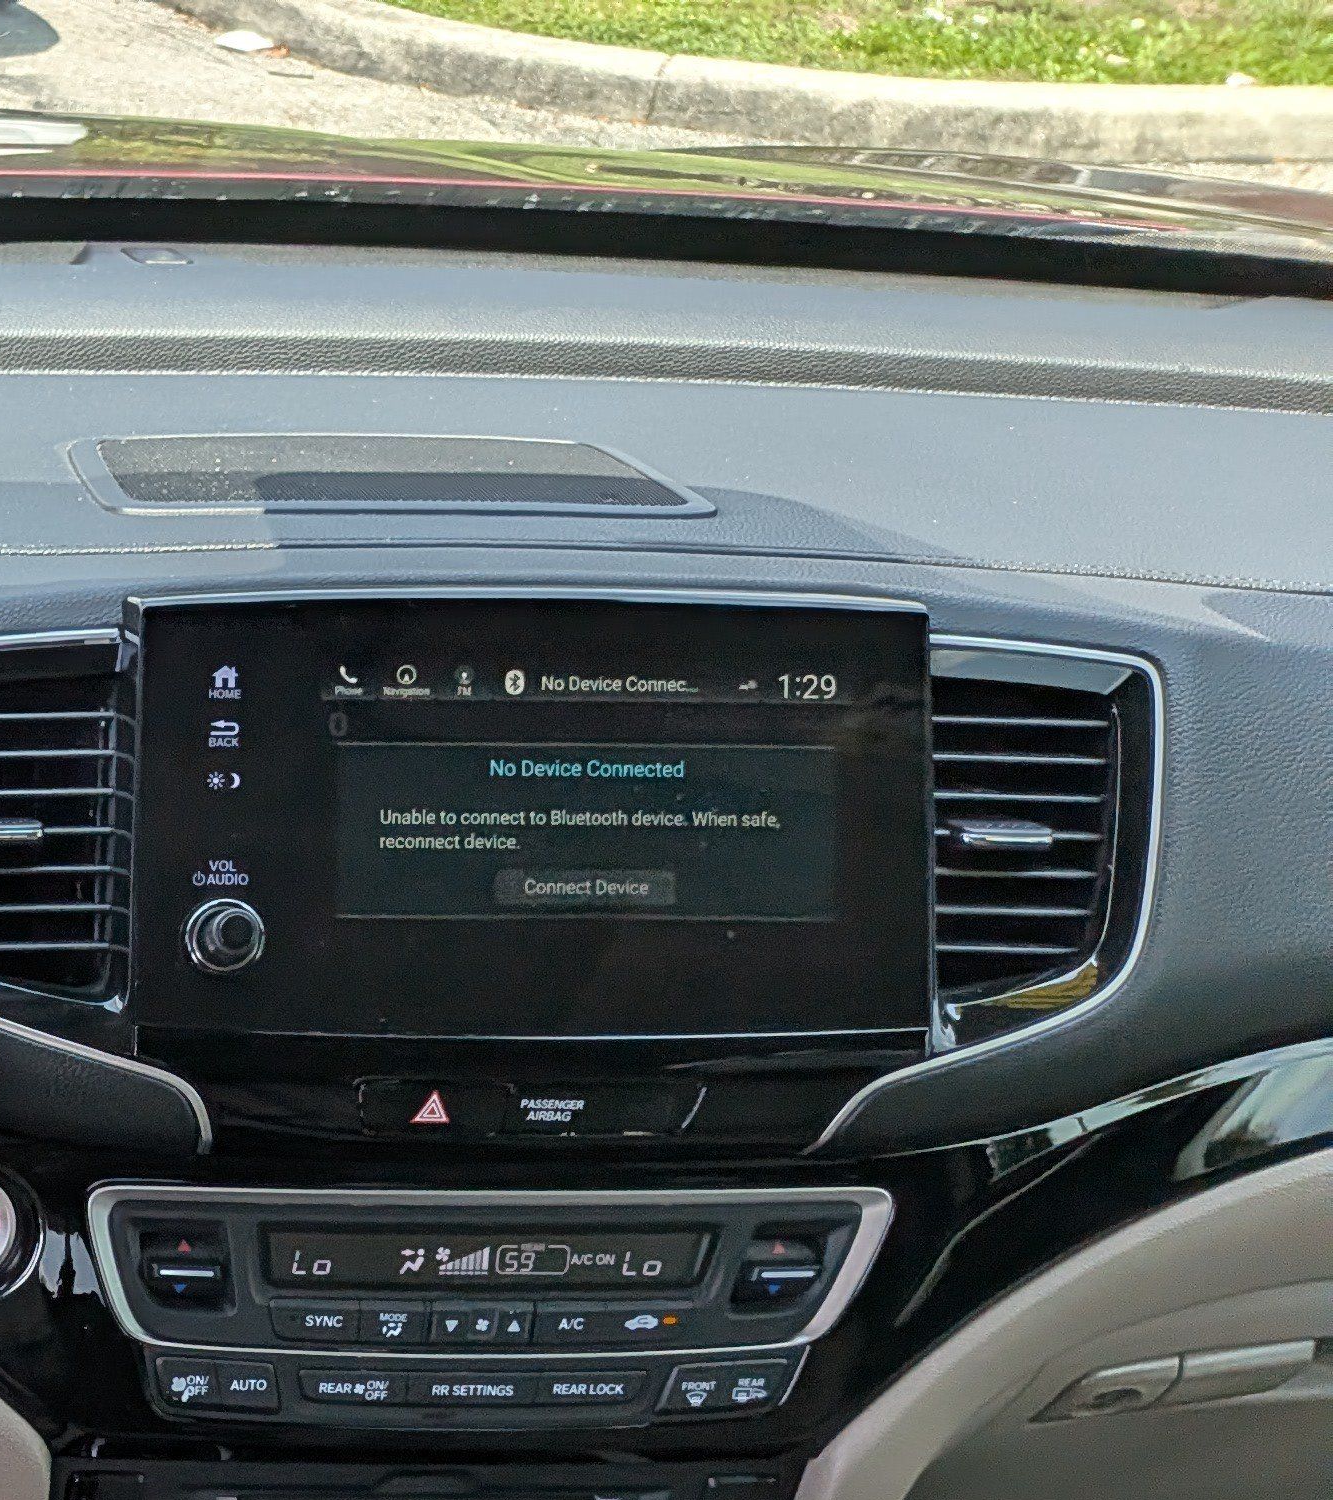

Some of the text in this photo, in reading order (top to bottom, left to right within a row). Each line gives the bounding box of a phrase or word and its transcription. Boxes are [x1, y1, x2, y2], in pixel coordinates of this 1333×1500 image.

[541, 676, 564, 691] No
[569, 676, 622, 692] Device
[778, 674, 836, 700] 1:29
[208, 688, 242, 700] HOME
[208, 737, 239, 747] BACK
[489, 759, 685, 778] No Device Connected
[380, 809, 781, 829] Unable to connect to Bluetooth device. When safe,
[379, 832, 520, 850] reconnect device.
[208, 860, 237, 872] VOL
[206, 873, 249, 886] AUDIO
[524, 879, 649, 895] Connect Device
[520, 1098, 585, 1110] PASSENGER
[526, 1110, 572, 1122] AIRBAG
[571, 1254, 615, 1266] A/C ON
[305, 1315, 343, 1328] SYNC
[379, 1314, 408, 1323] MODE
[558, 1317, 585, 1330] A/C
[230, 1379, 267, 1391] AUTO
[319, 1382, 352, 1394] REAR
[552, 1383, 624, 1395] REAR LOCK
[681, 1381, 716, 1392] FRONT
[738, 1378, 765, 1388] REAR
[185, 1386, 209, 1397] OFF
[365, 1390, 388, 1401] OFF
[432, 1384, 514, 1397] RR SETTINGS
